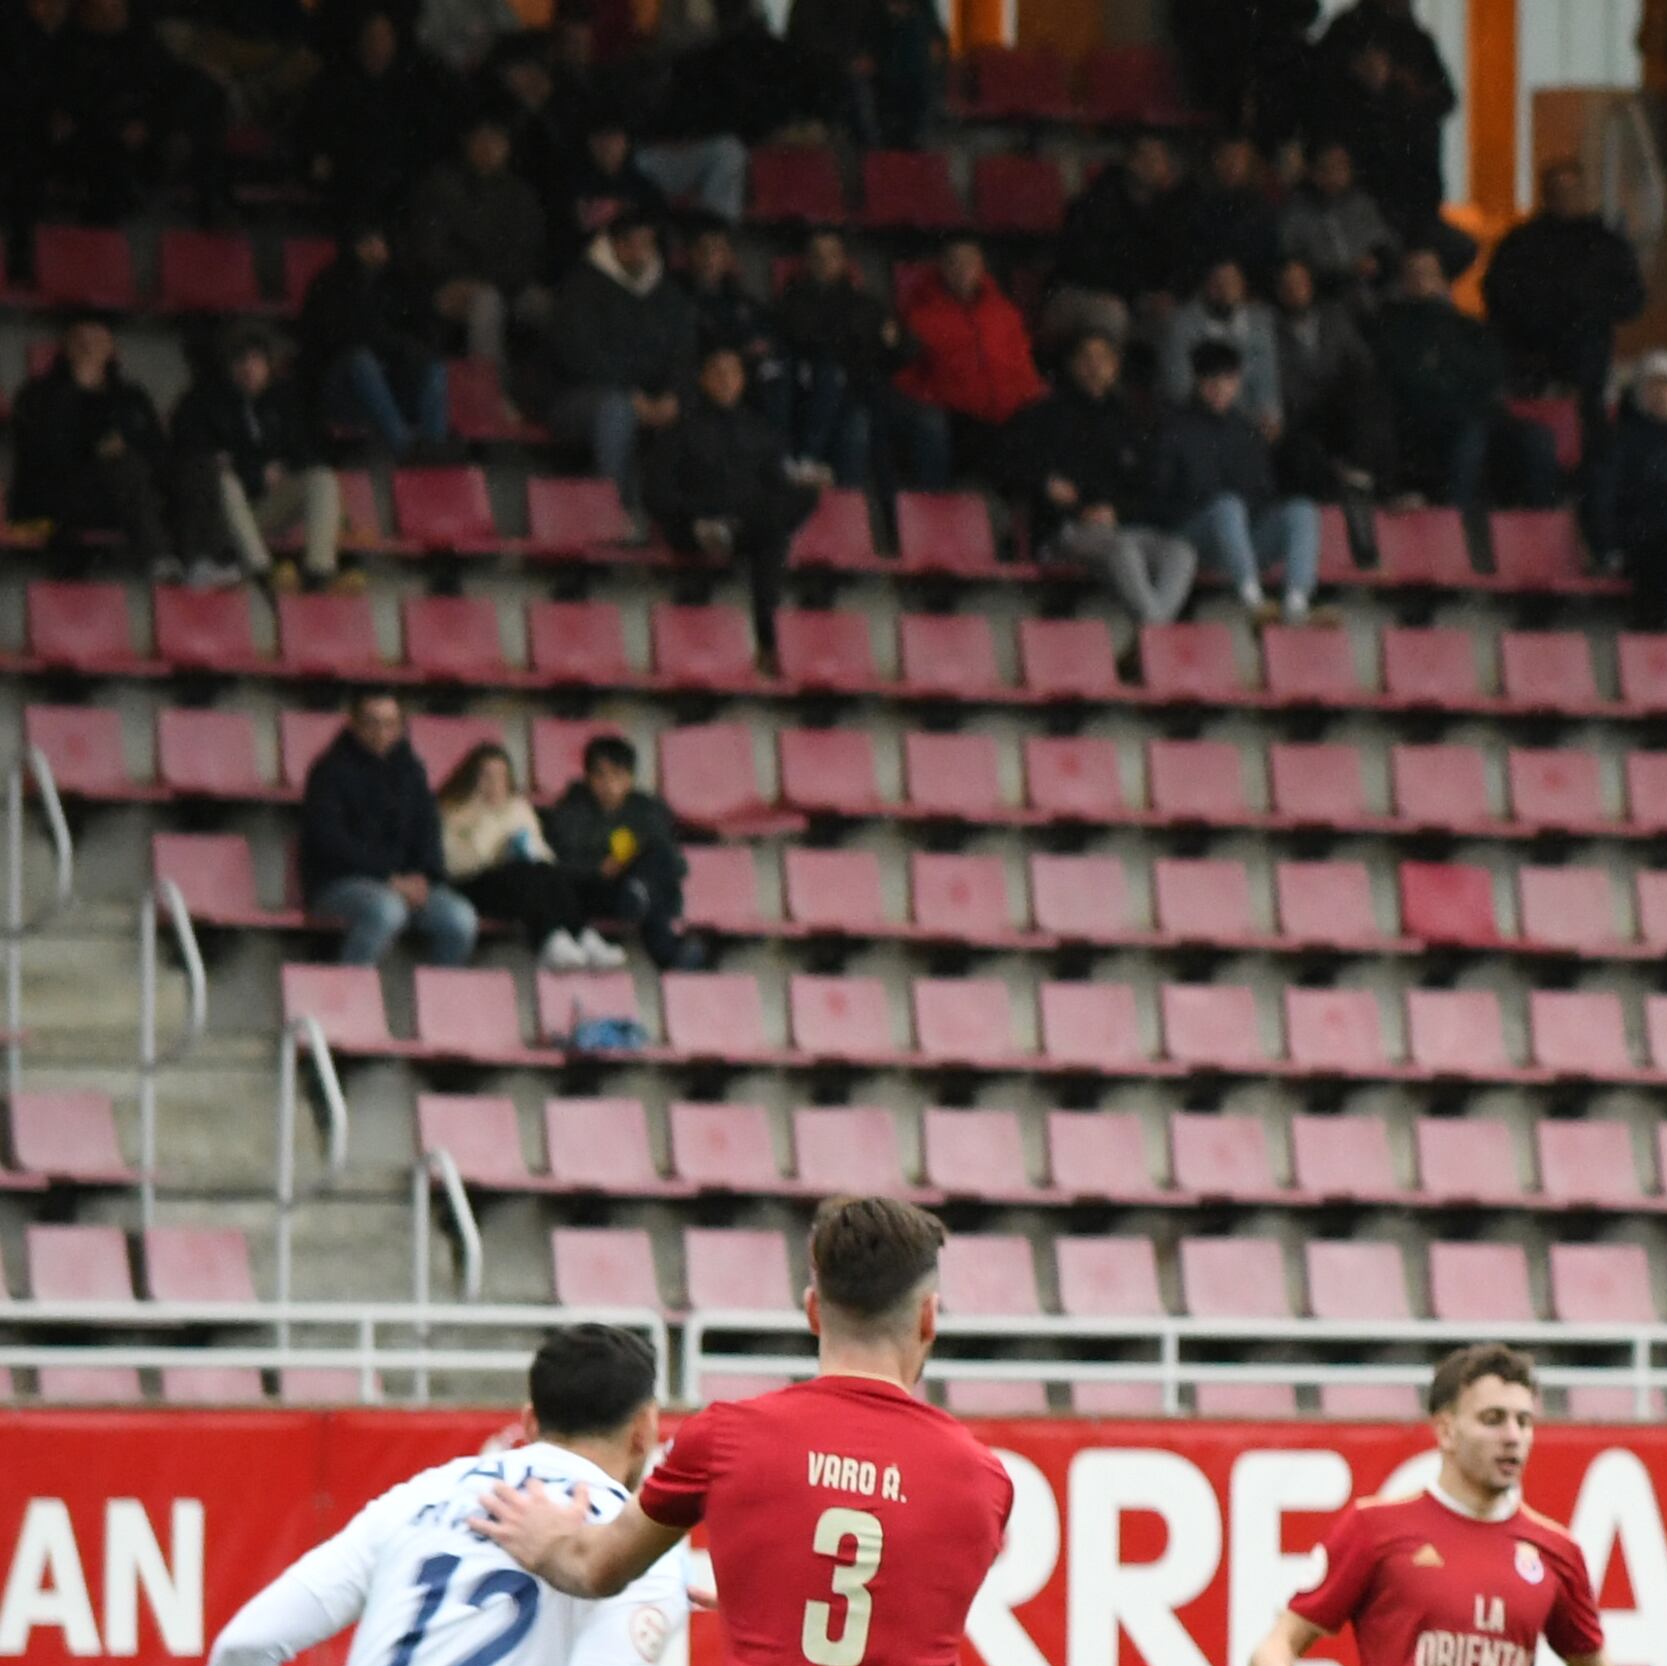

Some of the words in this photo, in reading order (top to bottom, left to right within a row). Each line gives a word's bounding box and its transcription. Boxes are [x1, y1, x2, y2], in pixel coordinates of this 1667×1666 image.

[808, 1451, 876, 1496] VARO
[0, 1498, 204, 1658] AN
[1474, 1593, 1505, 1633] LA
